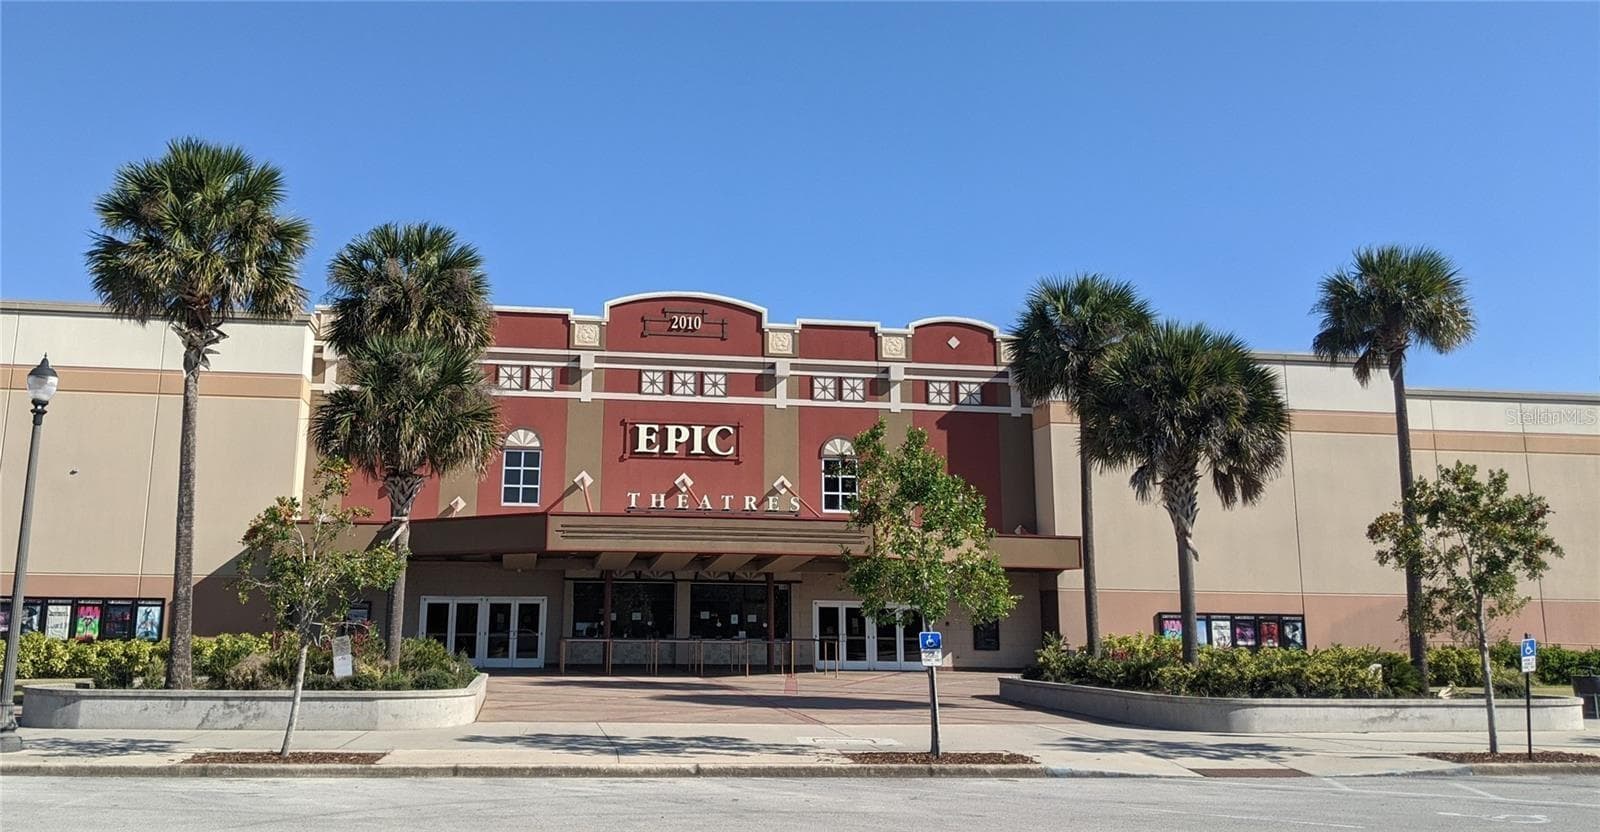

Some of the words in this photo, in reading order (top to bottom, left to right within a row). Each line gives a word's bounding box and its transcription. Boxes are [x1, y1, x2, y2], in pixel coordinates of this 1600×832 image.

[671, 315, 702, 330] 2010
[635, 423, 734, 456] EPIC
[627, 492, 801, 511] THEATRES
